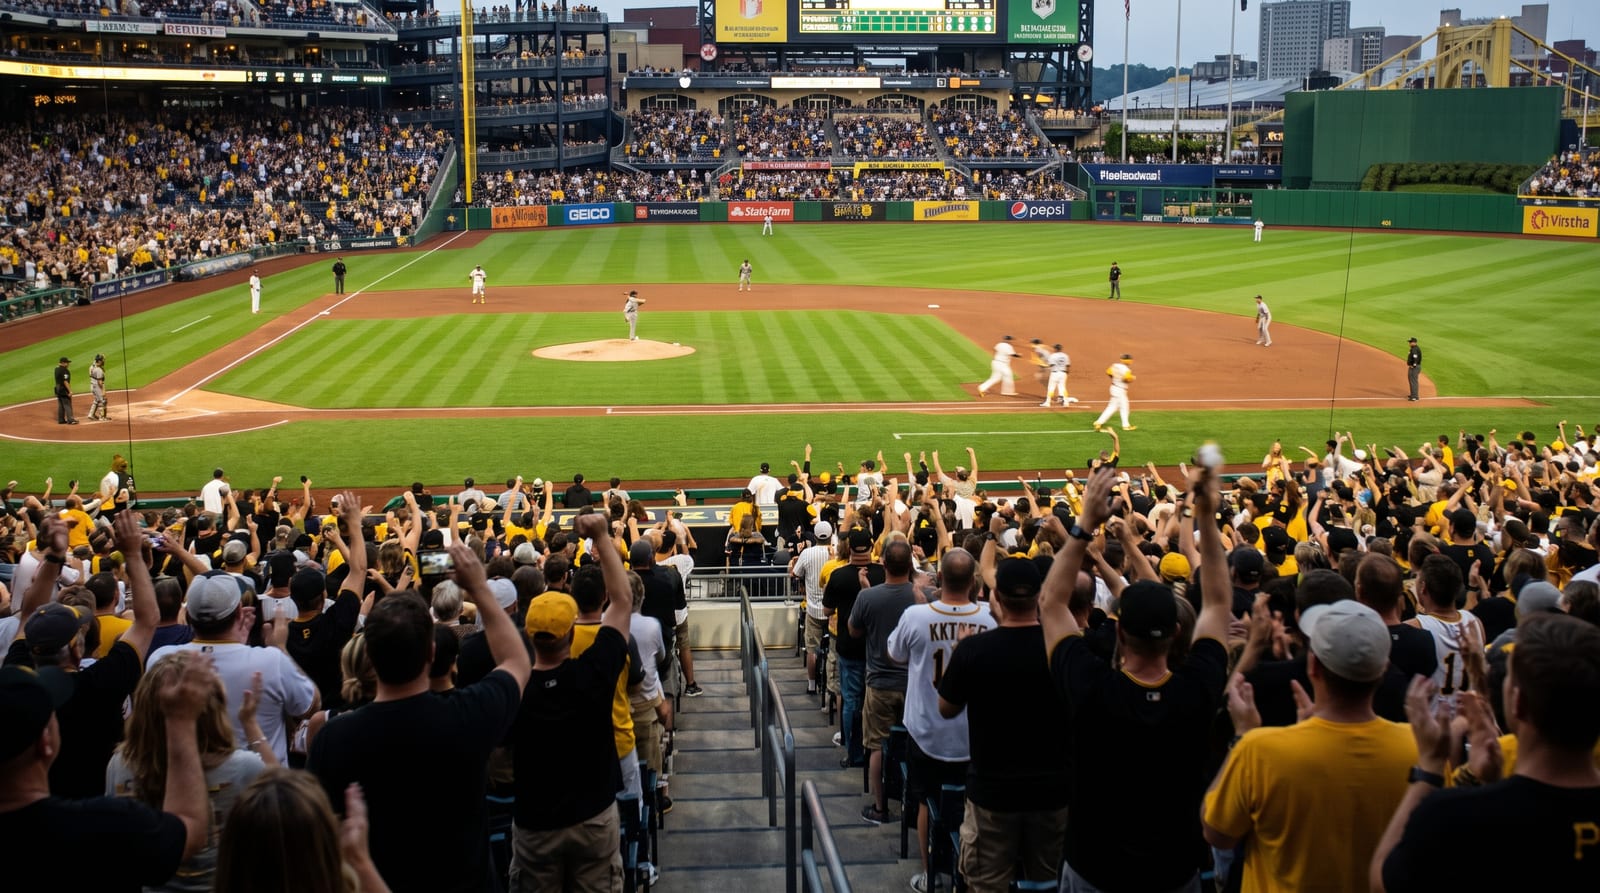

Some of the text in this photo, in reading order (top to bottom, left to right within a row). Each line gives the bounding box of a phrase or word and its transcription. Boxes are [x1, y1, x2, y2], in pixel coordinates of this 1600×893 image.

[569, 207, 610, 221] GEICO
[1029, 203, 1065, 218] pepsi
[1551, 213, 1590, 229] Virstha
